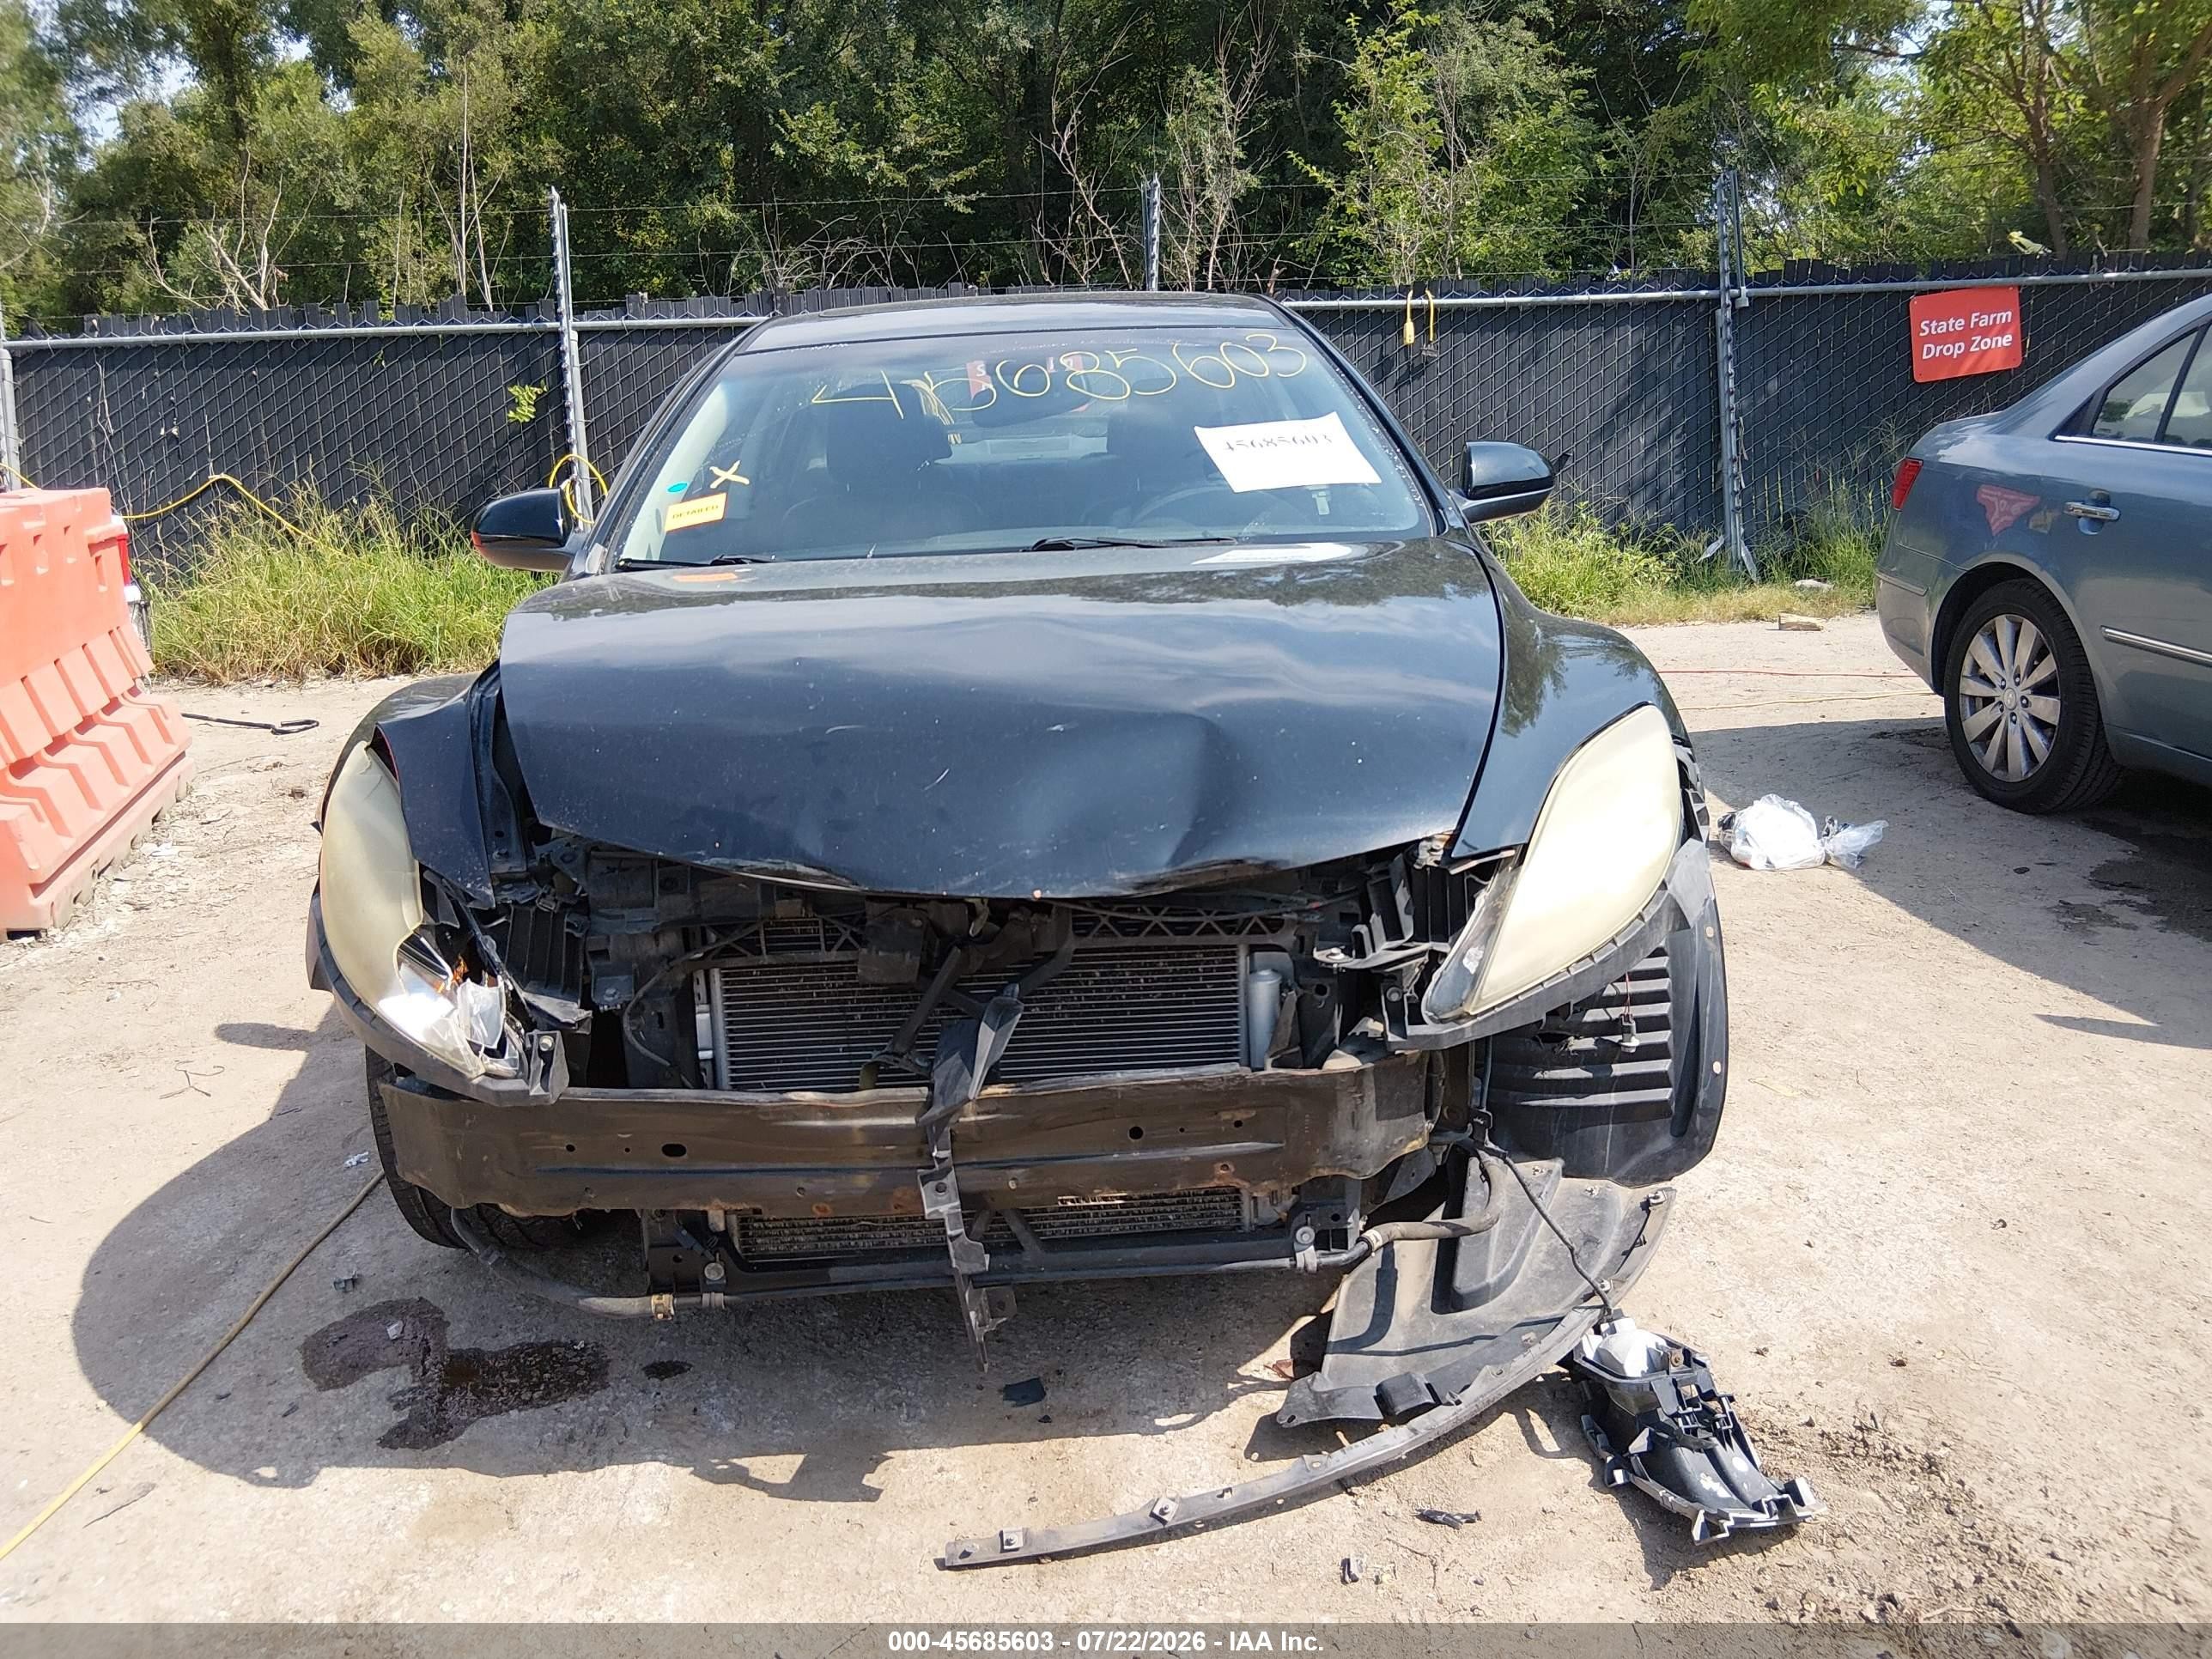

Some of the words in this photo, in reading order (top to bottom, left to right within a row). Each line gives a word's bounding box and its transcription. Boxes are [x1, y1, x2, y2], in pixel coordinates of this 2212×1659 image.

[1919, 317, 1965, 337] State
[1970, 310, 2012, 329] Farm
[1922, 342, 1965, 360] Drop
[1969, 334, 2013, 352] Zone
[811, 333, 1307, 420] 45685603
